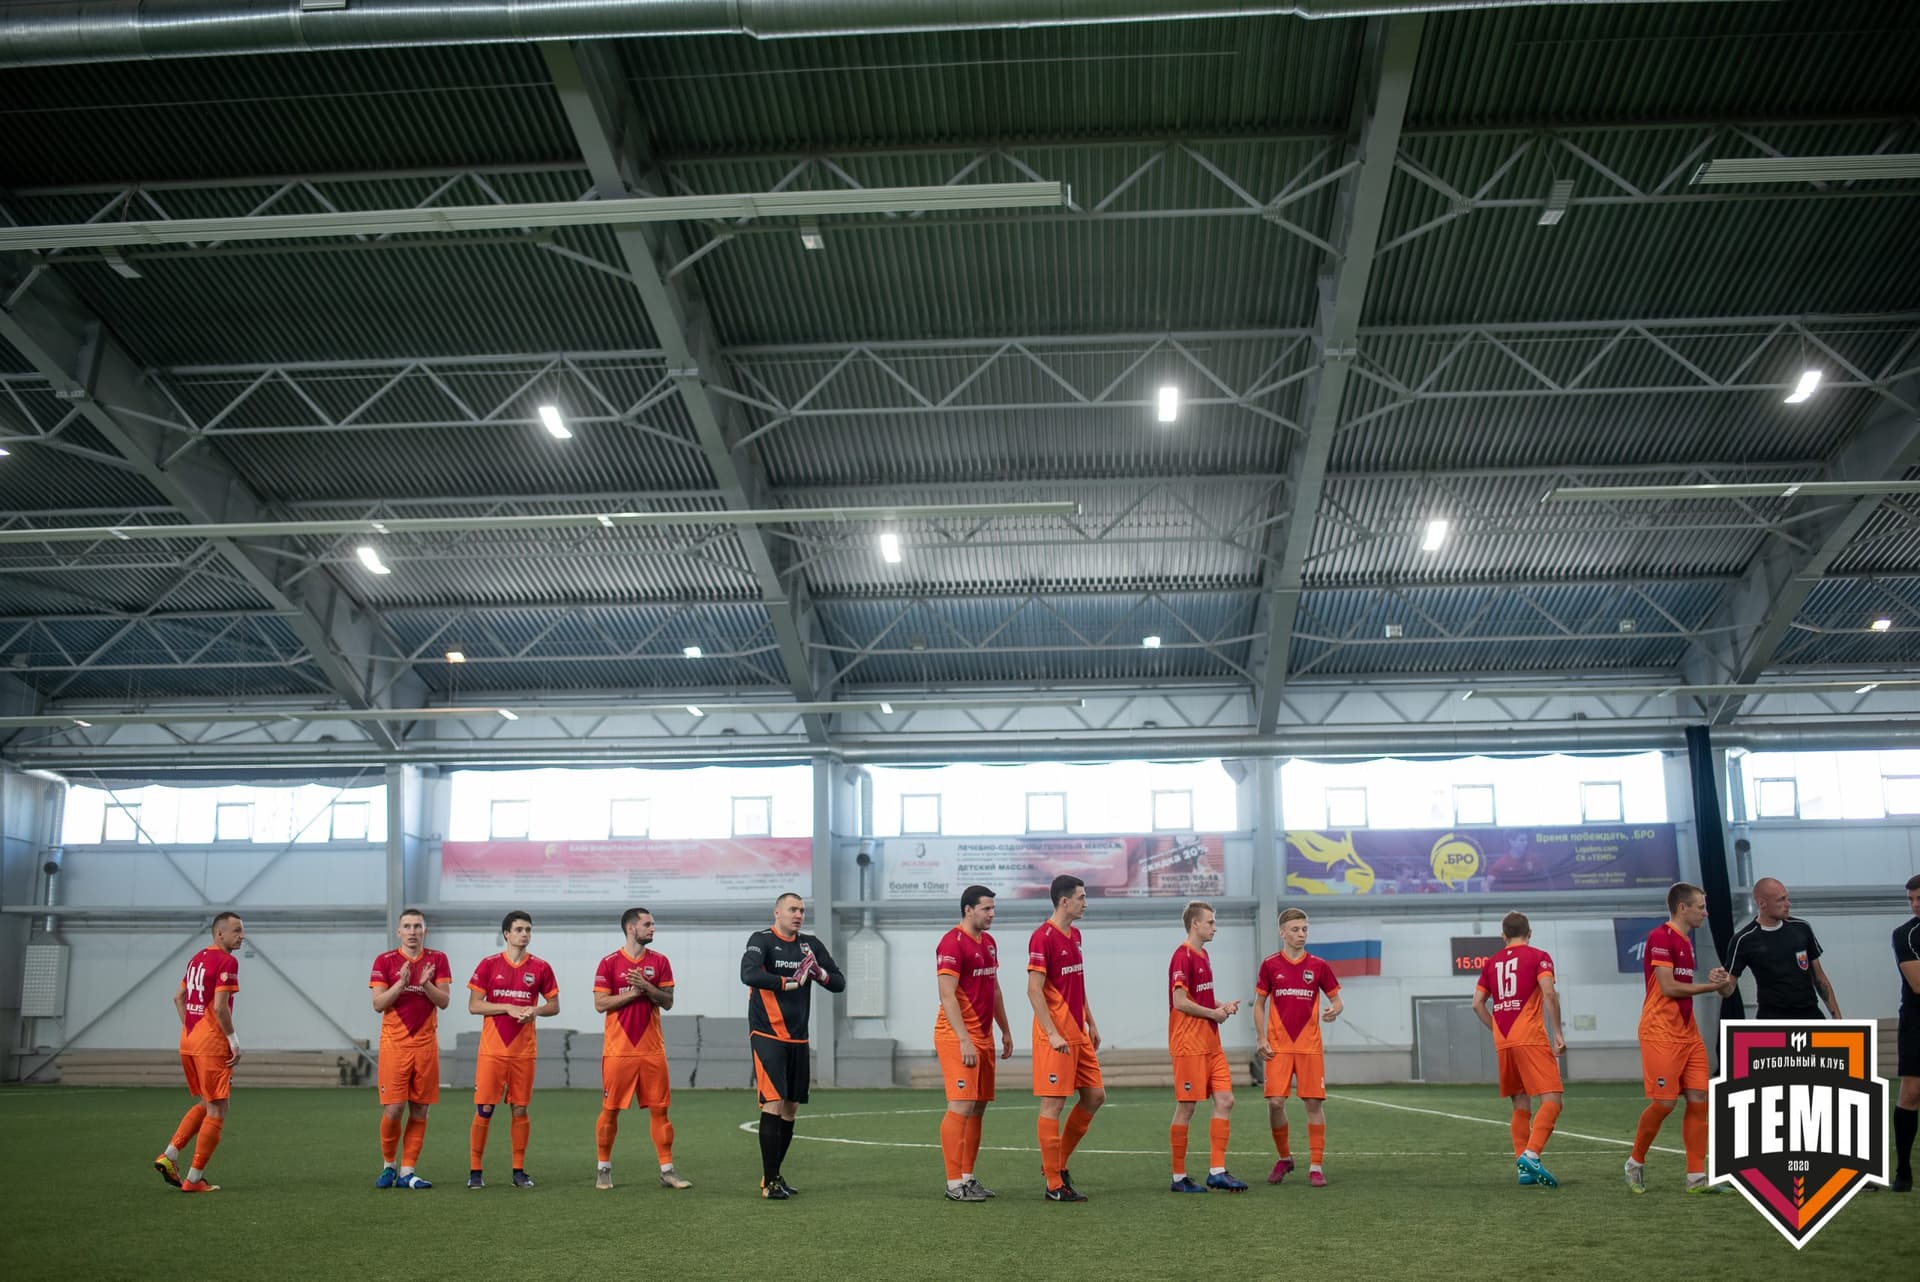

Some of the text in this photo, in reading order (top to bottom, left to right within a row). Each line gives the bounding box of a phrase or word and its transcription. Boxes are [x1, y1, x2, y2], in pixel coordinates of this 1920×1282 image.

[1536, 833, 1568, 844] Время
[1570, 831, 1628, 843] побеждать,
[1444, 853, 1474, 865] .БРО
[957, 863, 996, 872] ДЕТСКИЙ
[186, 960, 205, 1002] 44
[1495, 957, 1518, 1000] 15
